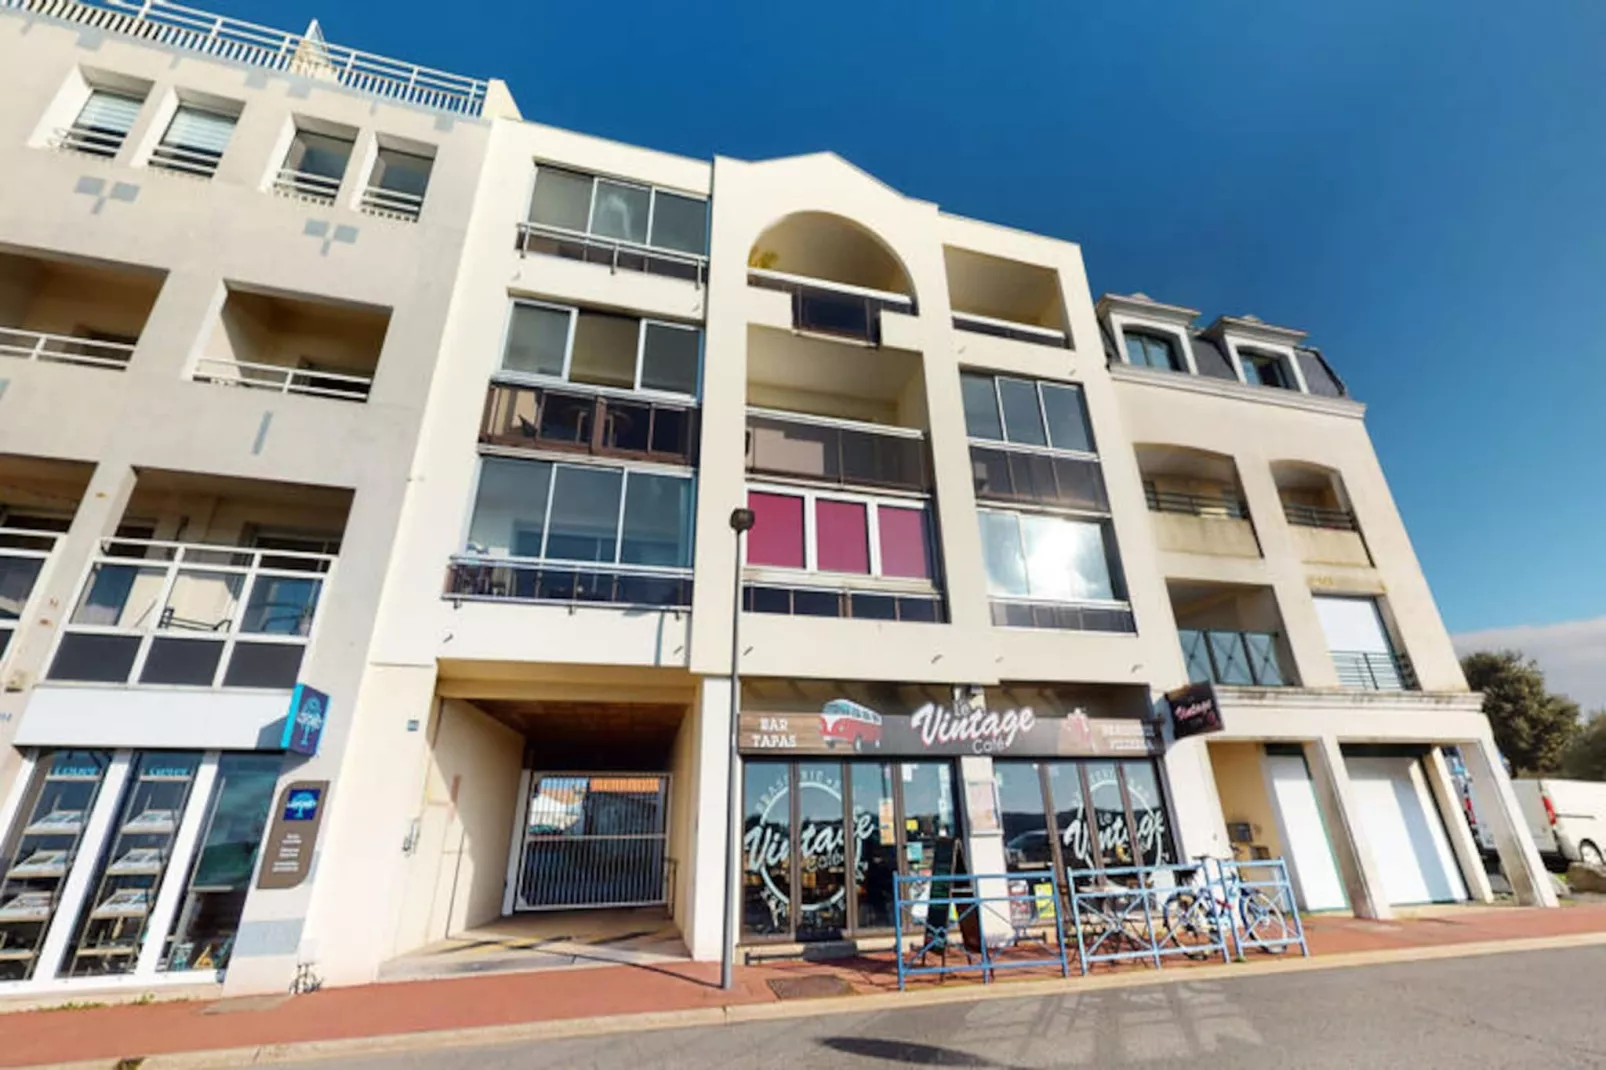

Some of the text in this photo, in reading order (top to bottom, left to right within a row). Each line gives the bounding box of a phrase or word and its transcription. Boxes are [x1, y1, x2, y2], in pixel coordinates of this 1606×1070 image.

[954, 700, 970, 717] Le
[760, 718, 788, 732] BAR
[910, 702, 1035, 750] Vintage
[751, 734, 797, 748] TAPAS
